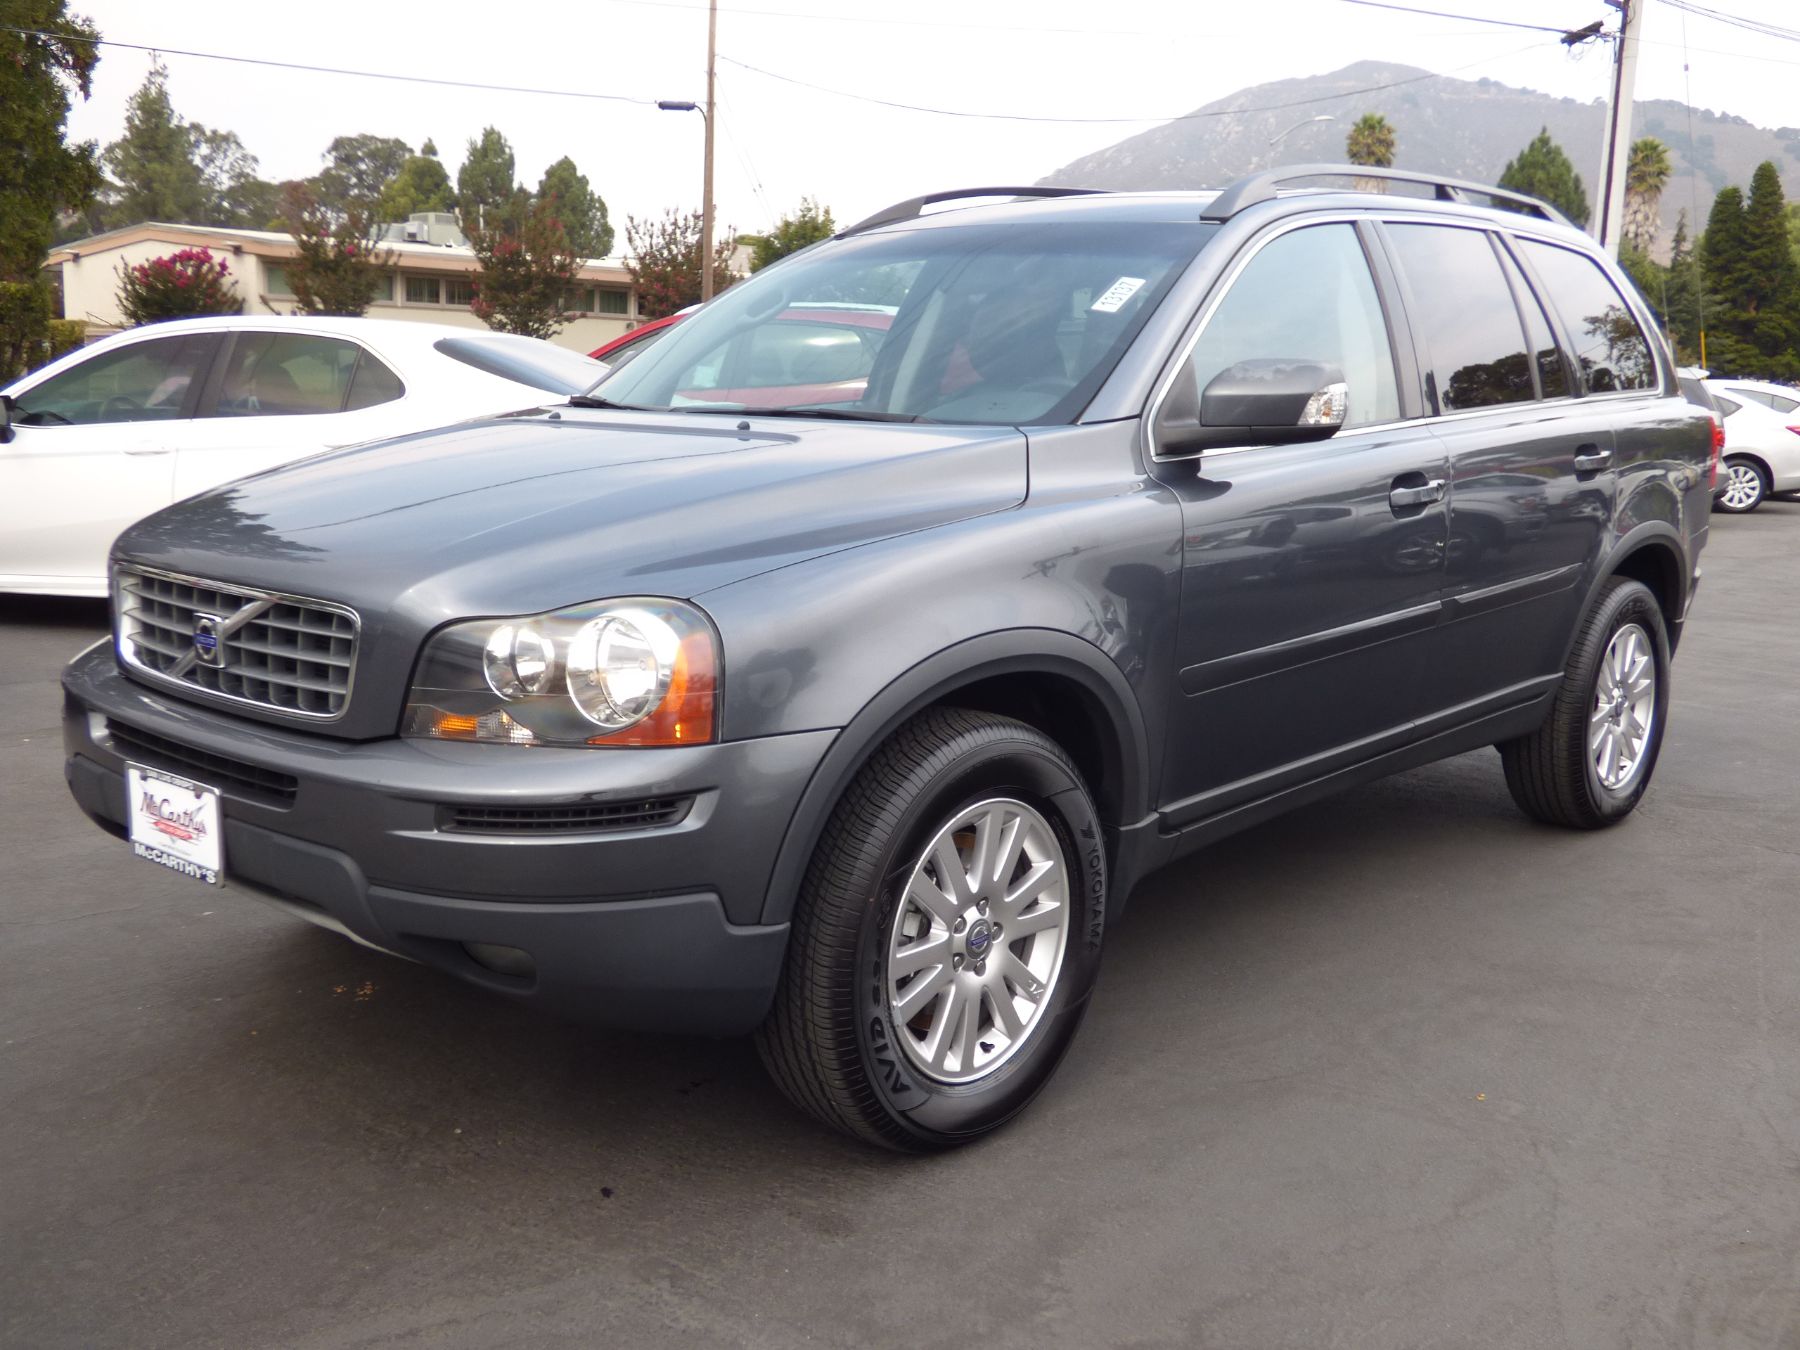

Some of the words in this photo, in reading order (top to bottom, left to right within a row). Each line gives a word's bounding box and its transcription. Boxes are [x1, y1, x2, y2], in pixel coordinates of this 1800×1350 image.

[134, 842, 217, 884] McCARTHY'S
[1087, 842, 1104, 953] YOKOHAMA
[869, 1014, 912, 1094] AVID
